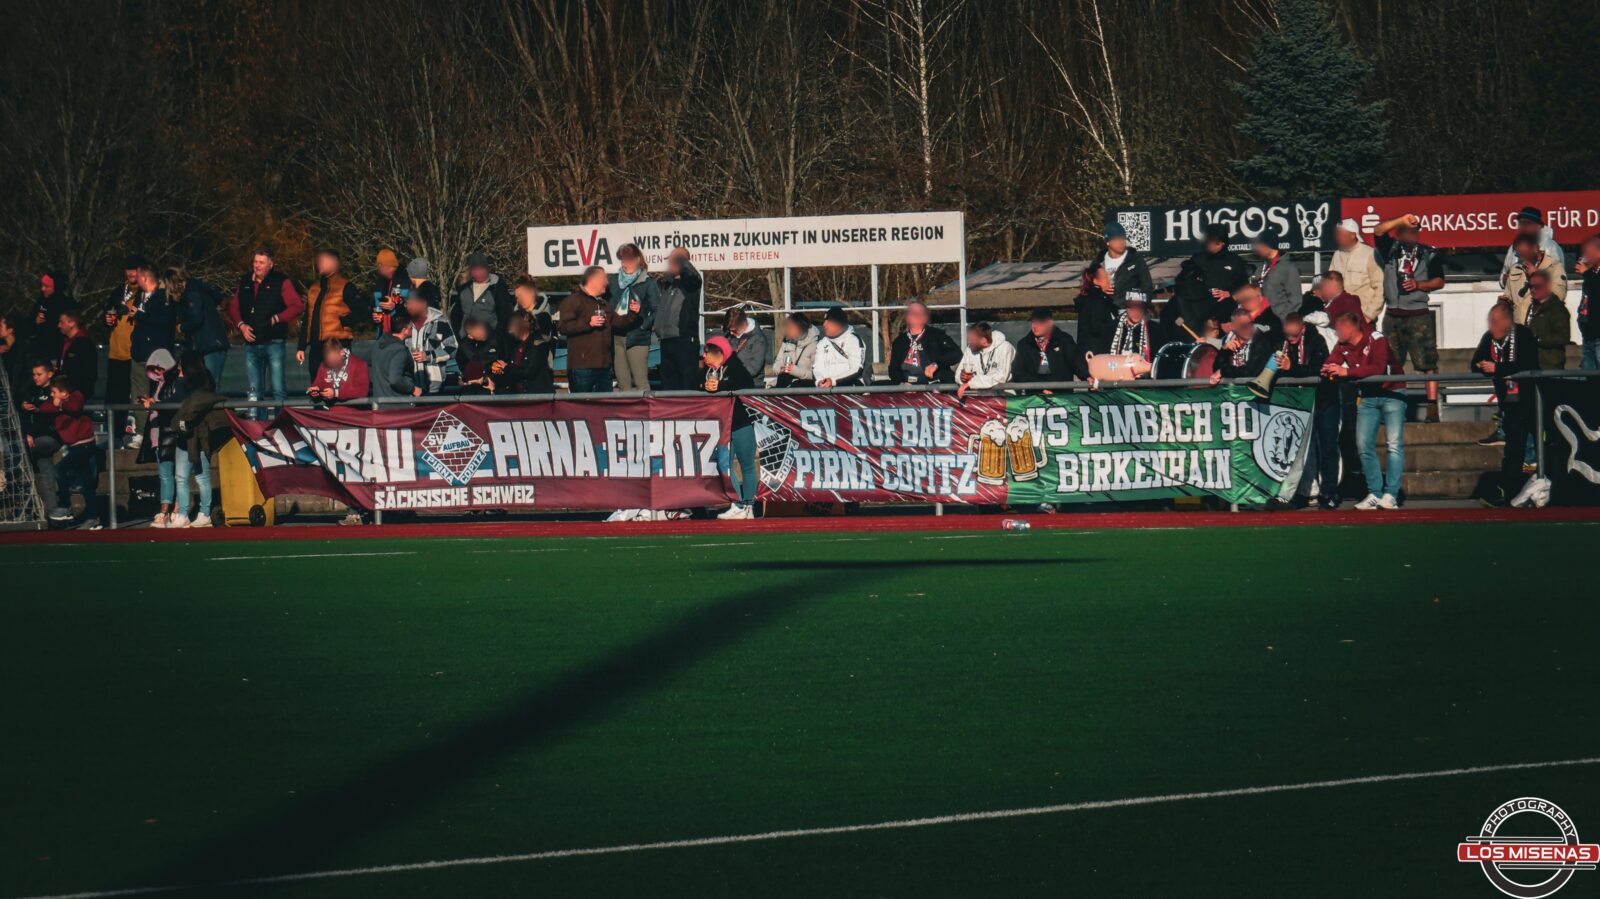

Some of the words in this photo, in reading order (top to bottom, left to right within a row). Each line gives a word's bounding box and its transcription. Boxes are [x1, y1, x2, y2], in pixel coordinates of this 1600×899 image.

[1164, 206, 1289, 241] HUGOS
[1547, 206, 1582, 228] FÜR
[544, 229, 613, 268] GEVA
[634, 235, 661, 250] WIR
[665, 230, 730, 249] FÖRDERN
[733, 230, 799, 247] ZUKUNFT
[803, 230, 817, 244] IN
[822, 227, 887, 243] UNSERER
[891, 225, 944, 241] REGION
[733, 250, 780, 261] BETREUEN
[800, 408, 837, 445] SV
[849, 407, 954, 448] AUFBAU
[1025, 406, 1068, 447] VS
[1078, 402, 1211, 446] LIMBACH
[1220, 401, 1260, 441] 90
[428, 434, 443, 446] SV
[443, 439, 470, 451] AUFBAU
[487, 420, 599, 477] PIRNA
[604, 419, 721, 478] COPITZ
[757, 433, 780, 448] UFBAU
[426, 456, 454, 484] PIRNA
[460, 451, 484, 482] COPITZ
[793, 449, 876, 490] PIRNA
[880, 453, 977, 495] COPITZ
[1055, 448, 1232, 493] BIRKENHAIN
[375, 486, 469, 510] SÄCHSISCHE
[473, 484, 535, 505] SCHWEIZ
